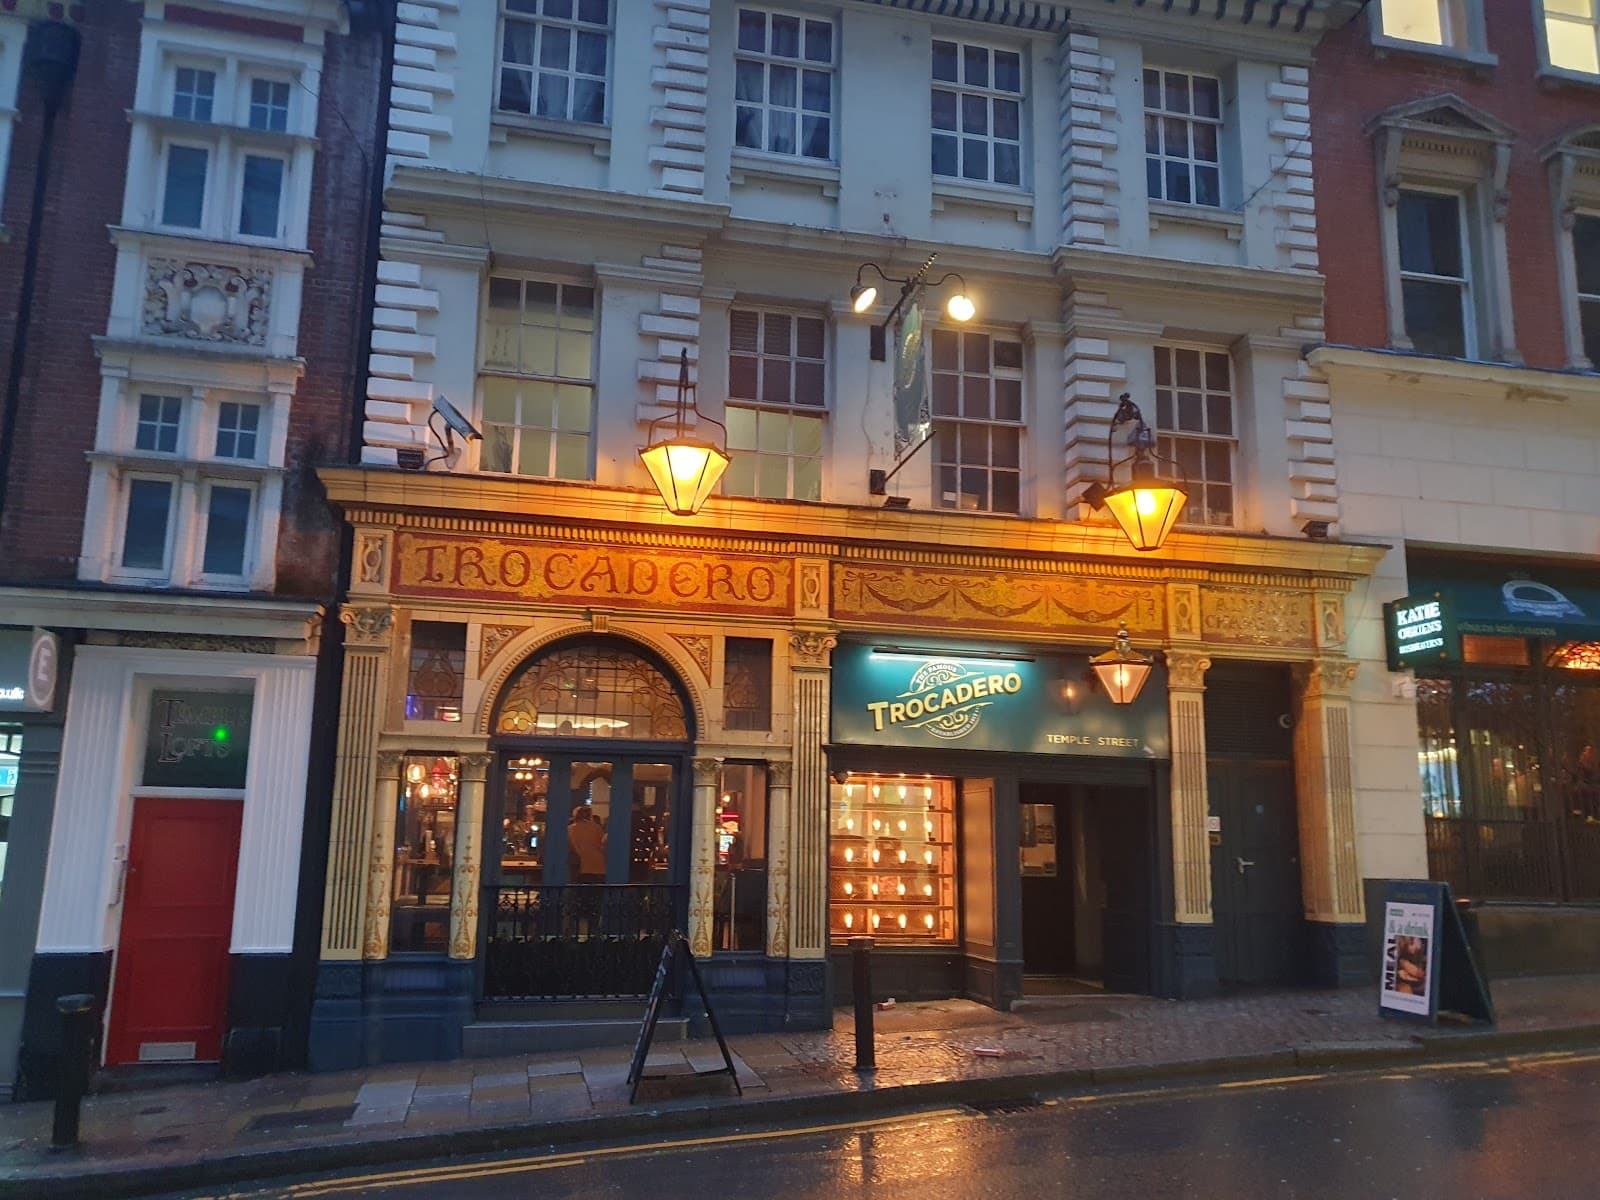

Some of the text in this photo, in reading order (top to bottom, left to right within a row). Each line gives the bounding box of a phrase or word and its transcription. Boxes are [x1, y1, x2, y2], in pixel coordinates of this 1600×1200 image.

[415, 545, 775, 601] TROCADERO
[1396, 601, 1441, 625] KATIE
[915, 669, 929, 685] THE
[867, 673, 1022, 730] TROCADERO
[1046, 734, 1139, 748] TEMPLE STREET
